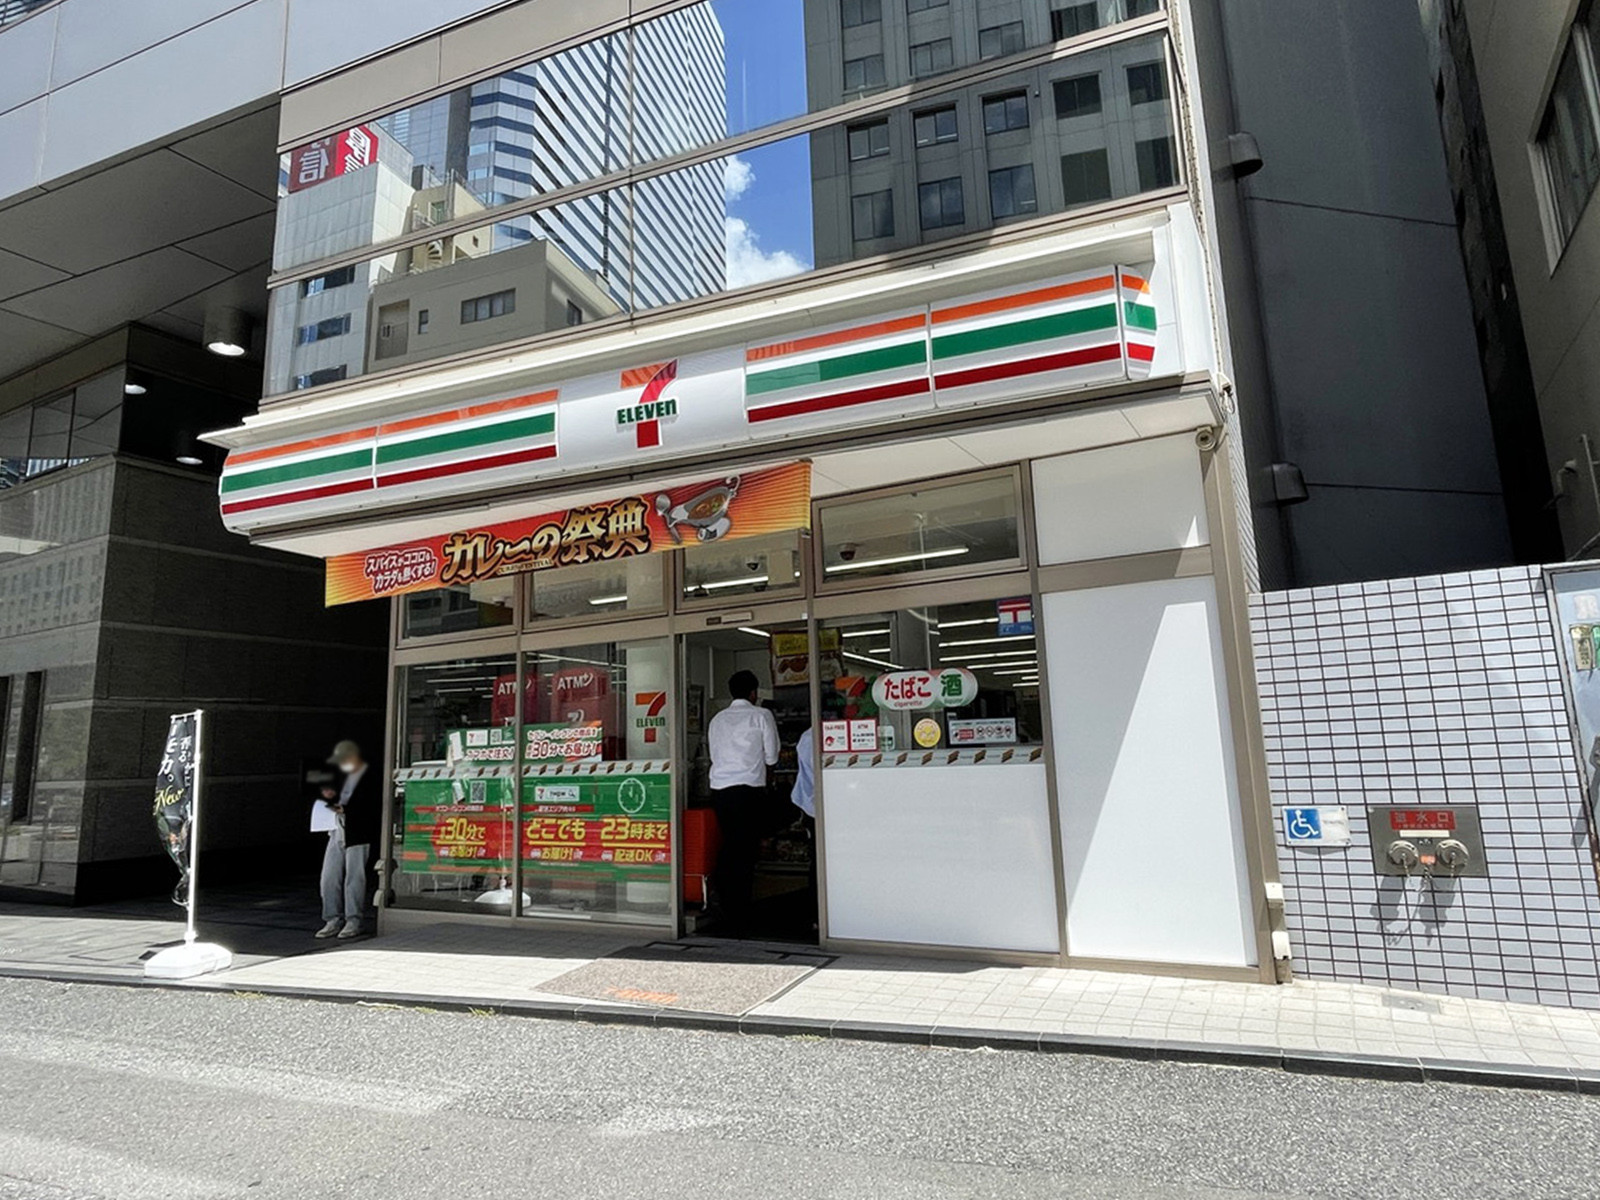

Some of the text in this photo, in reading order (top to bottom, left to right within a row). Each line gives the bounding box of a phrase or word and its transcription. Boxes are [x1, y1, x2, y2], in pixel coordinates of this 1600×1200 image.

[442, 499, 650, 582] カレーの祭典
[498, 681, 517, 695] AT
[557, 674, 584, 691] ATM
[884, 677, 932, 700] たばこ
[940, 674, 962, 697] 酒
[526, 818, 586, 840] どこでも
[600, 817, 668, 841] 23時まで
